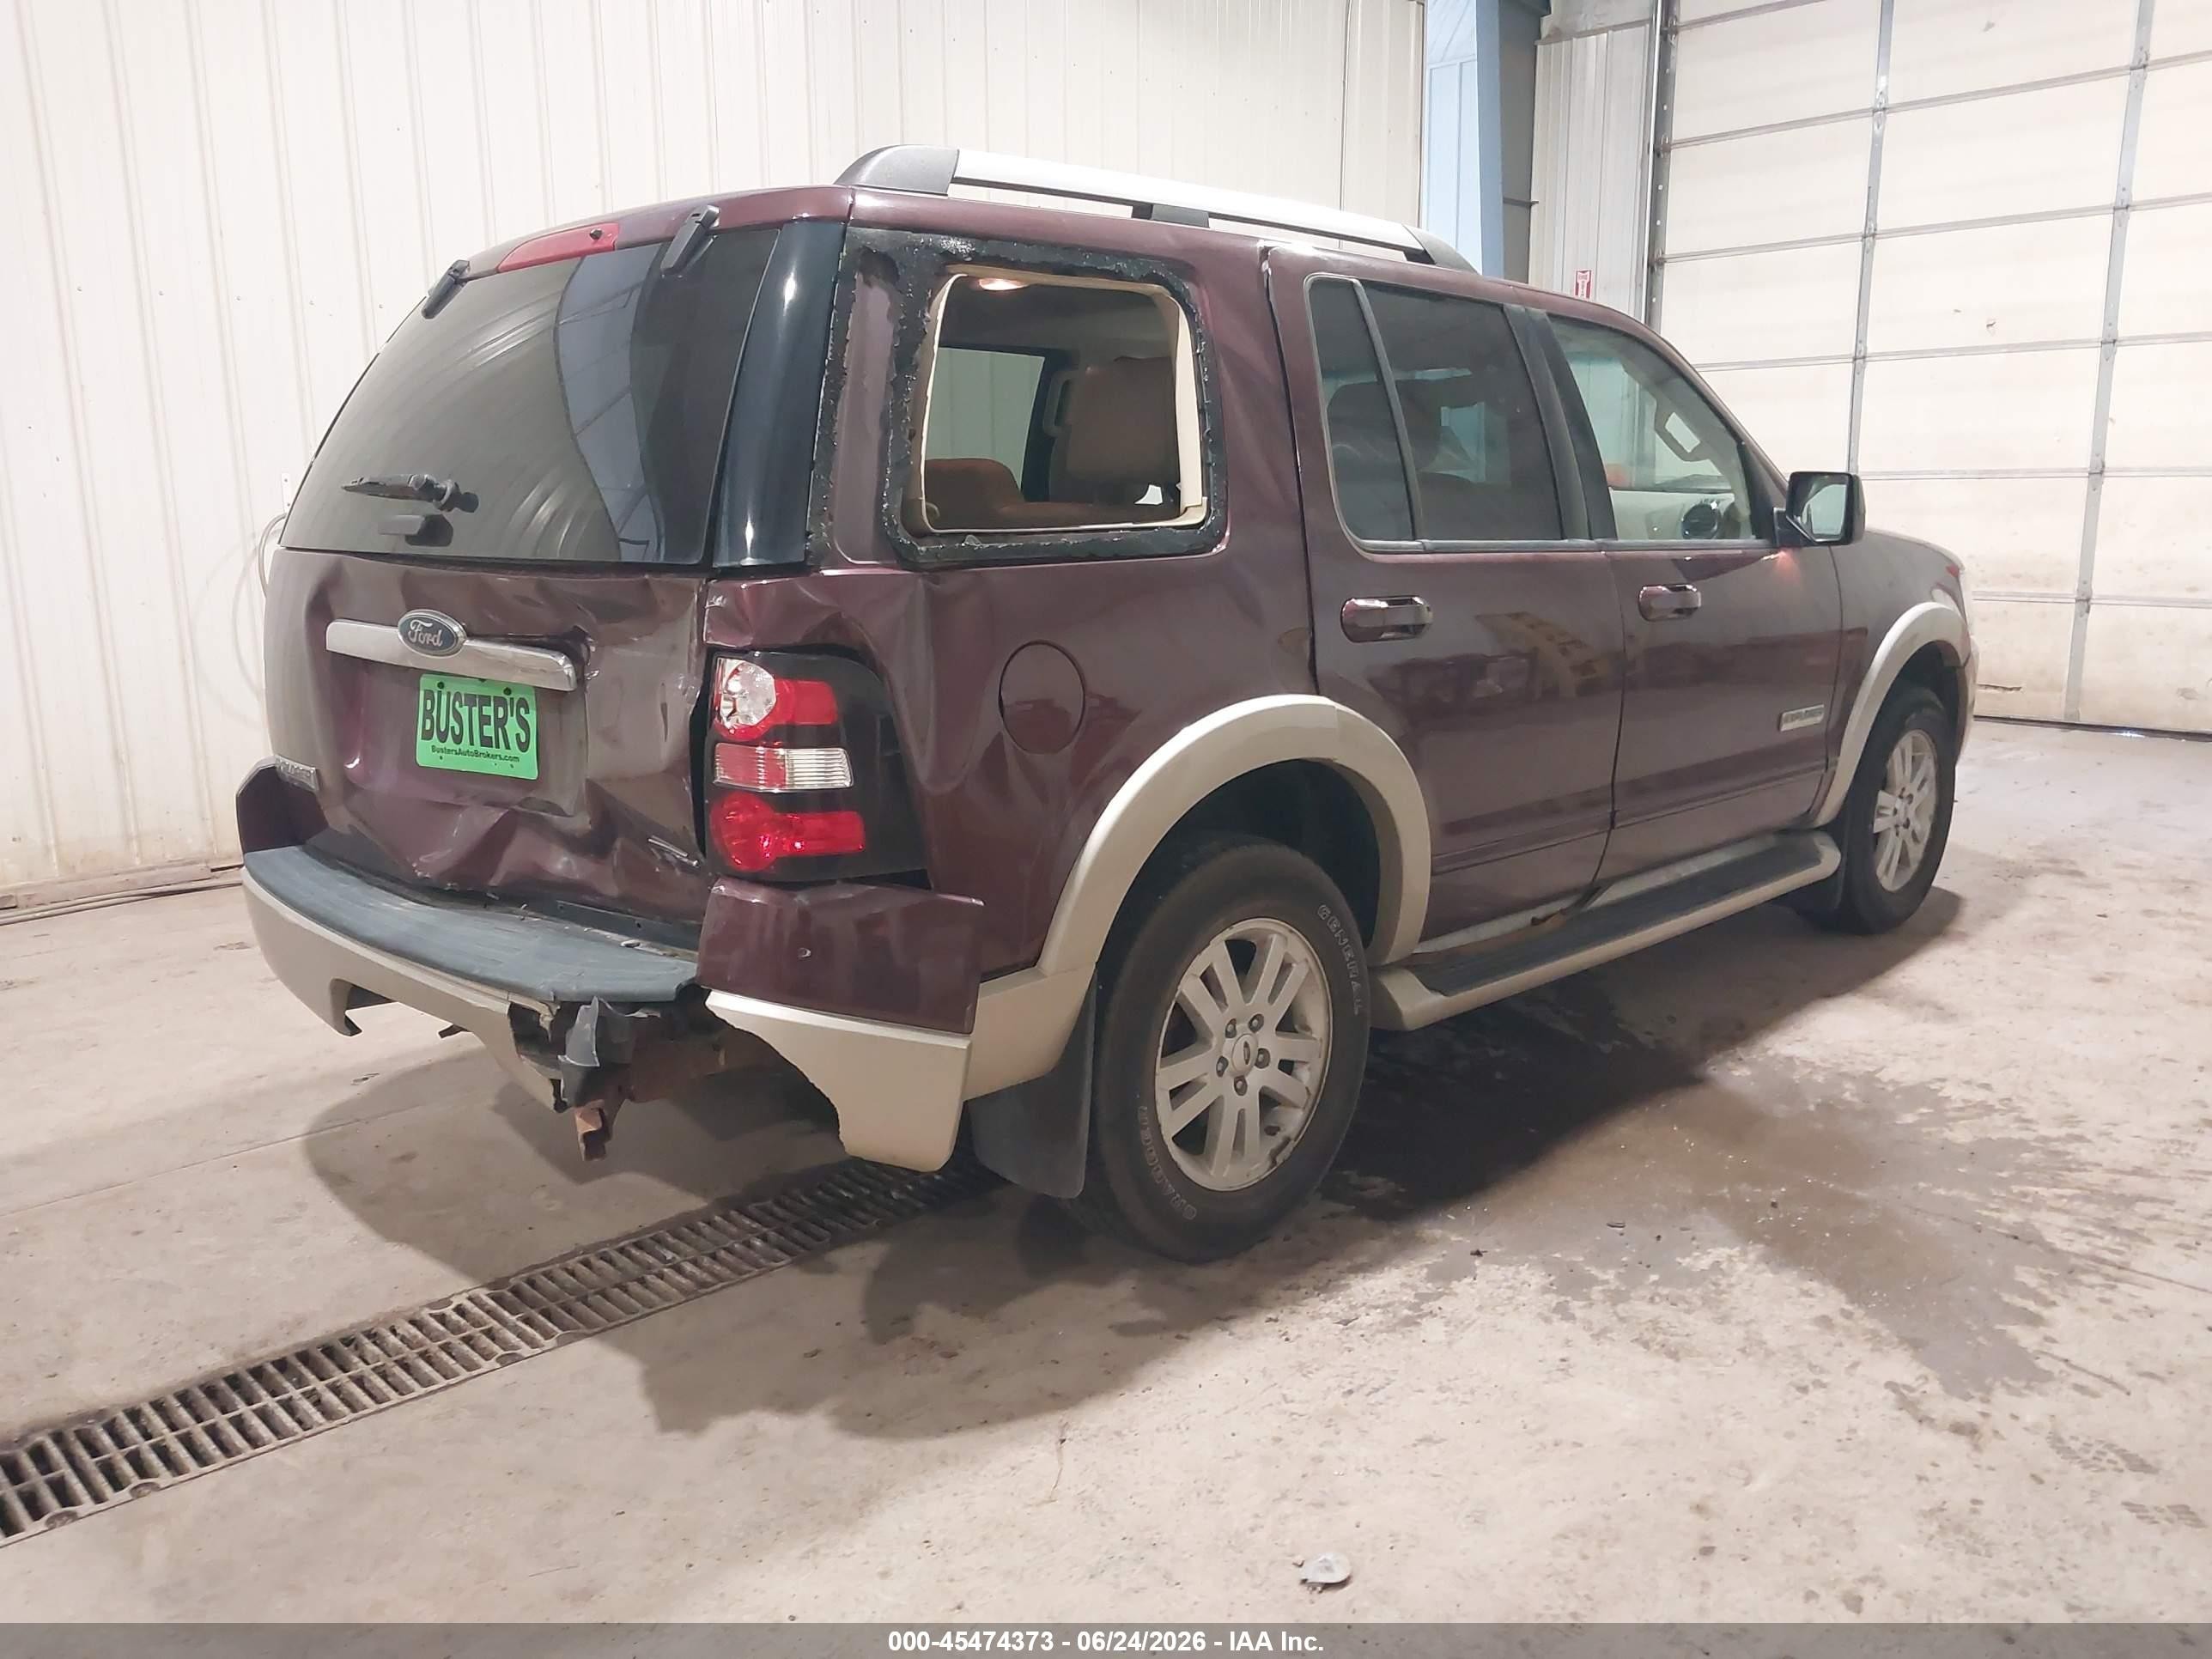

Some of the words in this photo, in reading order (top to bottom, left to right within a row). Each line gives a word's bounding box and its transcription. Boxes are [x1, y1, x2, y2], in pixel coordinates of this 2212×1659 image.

[408, 619, 443, 647] Ford
[421, 689, 531, 753] BUSTER'S
[431, 744, 520, 763] BustersAutoBrokers.com
